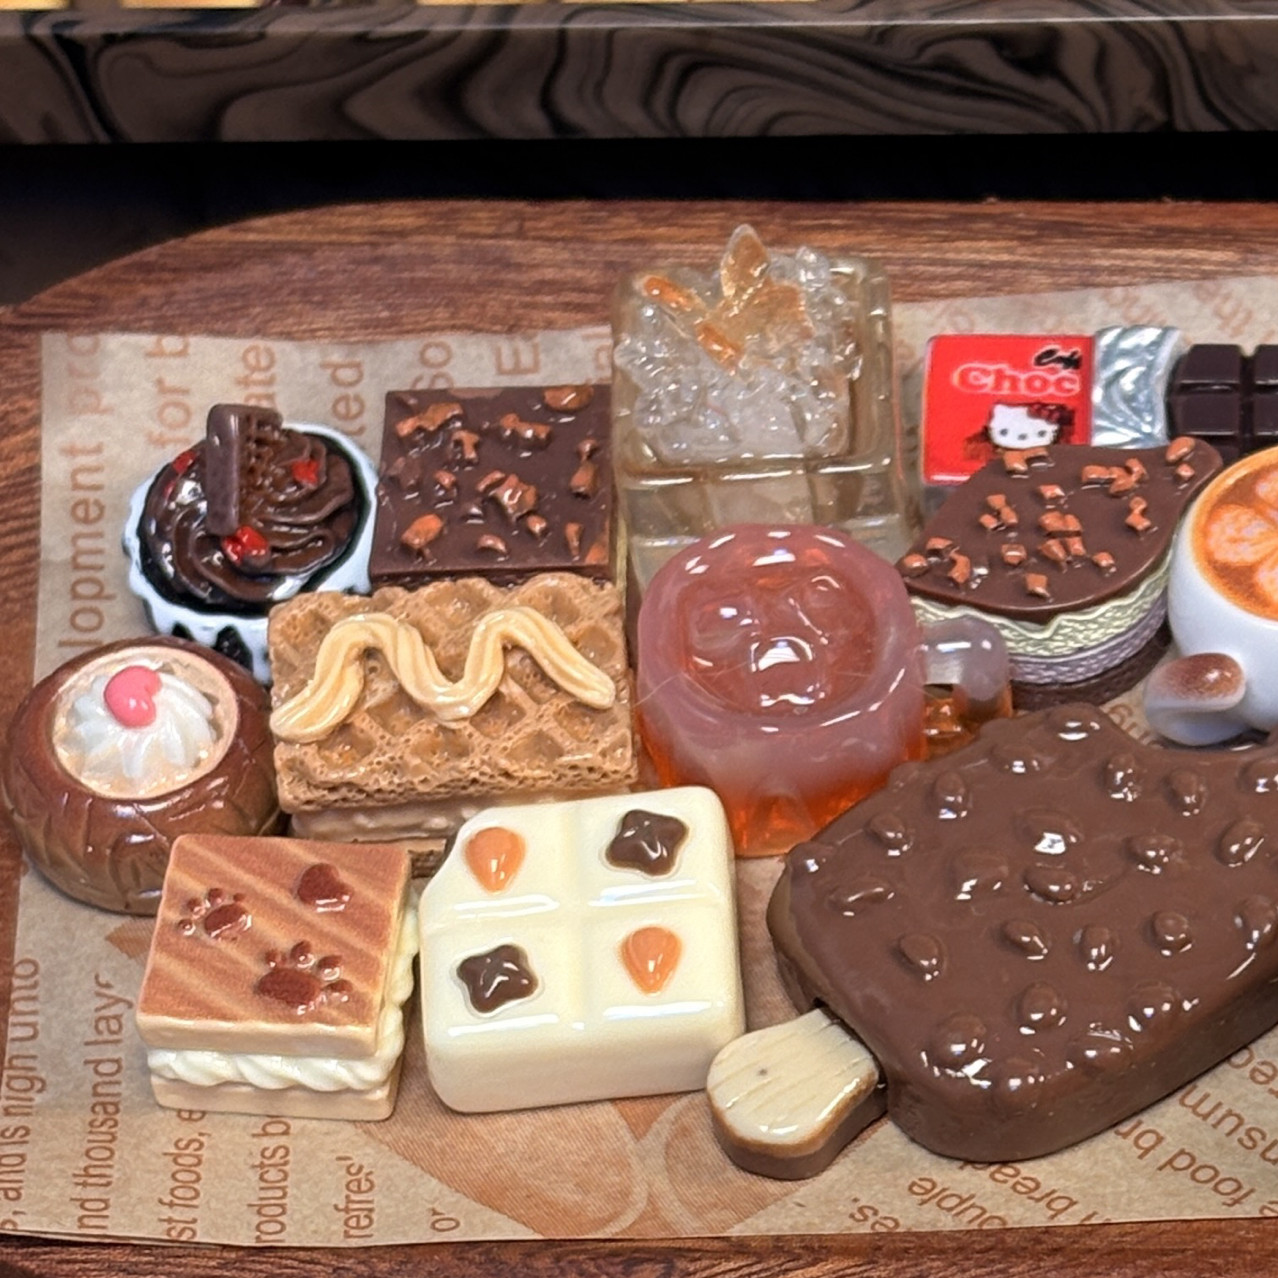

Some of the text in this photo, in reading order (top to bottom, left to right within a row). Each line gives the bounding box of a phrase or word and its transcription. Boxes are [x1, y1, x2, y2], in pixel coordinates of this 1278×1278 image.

[952, 363, 1081, 397] Choc
[72, 1056, 124, 1189] thousand
[157, 1131, 213, 1210] foods,
[1156, 1147, 1257, 1207] food
